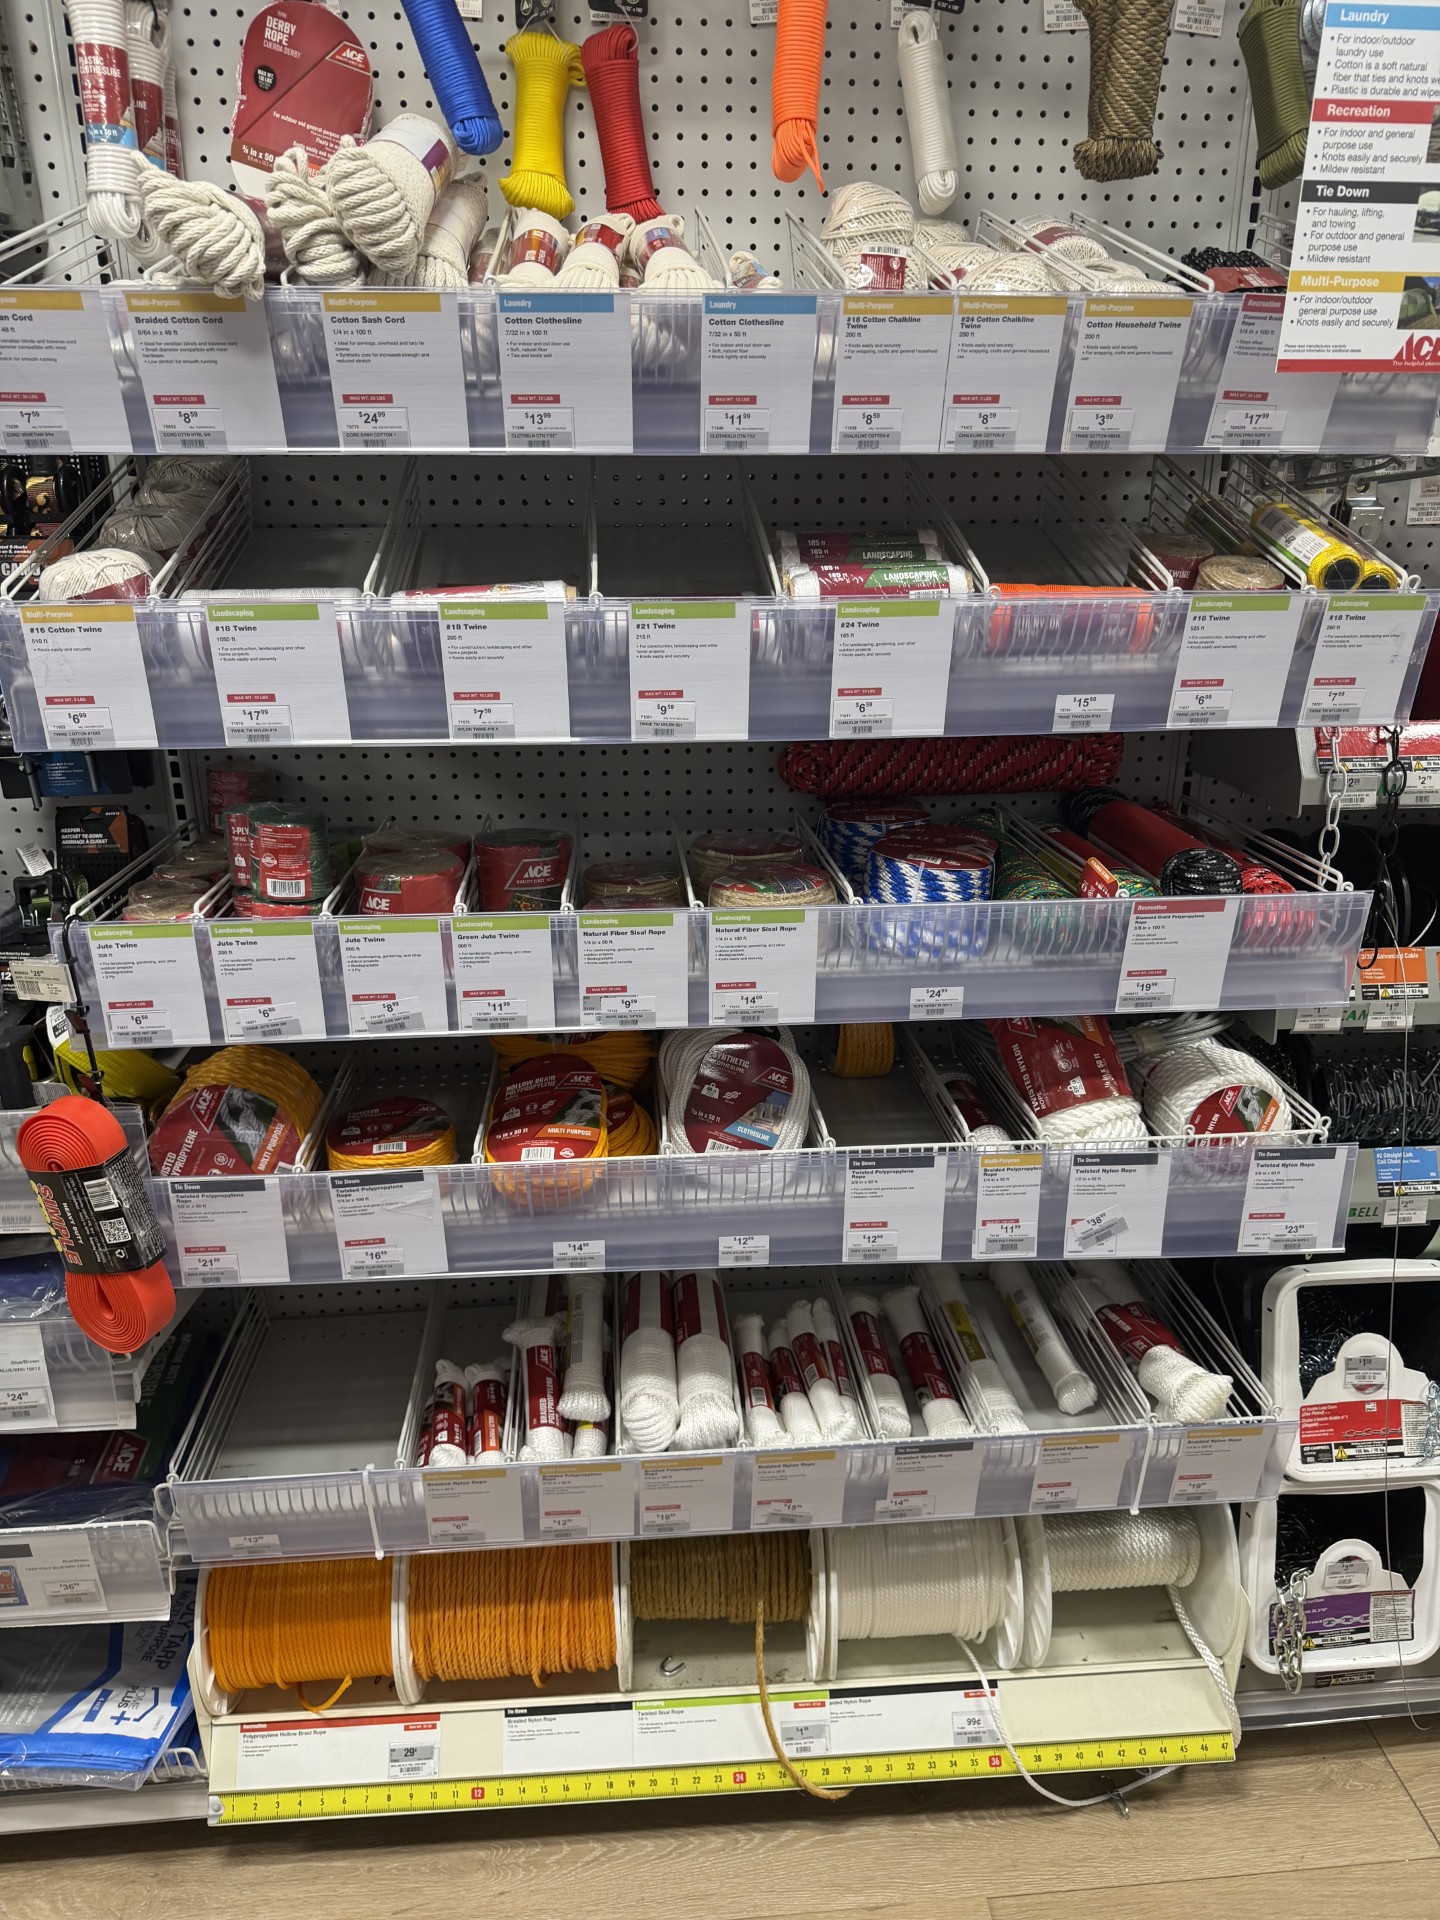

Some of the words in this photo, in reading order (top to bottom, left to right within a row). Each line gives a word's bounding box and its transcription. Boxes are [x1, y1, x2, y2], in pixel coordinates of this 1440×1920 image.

[1340, 9, 1390, 24] Laundry
[267, 15, 297, 36] DERBY
[264, 28, 288, 46] ROPE
[1336, 34, 1351, 44] For
[1353, 34, 1416, 46] indoor/outdoor
[263, 40, 284, 54] CUERDA
[284, 47, 302, 59] DERBY
[342, 48, 364, 63] ACE
[1335, 46, 1366, 58] laundry
[1368, 50, 1384, 58] use
[78, 56, 104, 66] PLASTIC
[80, 66, 122, 78] CLOTHESLINE
[1327, 104, 1391, 117] Recreation
[280, 113, 297, 125] outdoor
[298, 119, 306, 127] and
[306, 122, 322, 133] general
[322, 128, 340, 140] purpose
[1324, 128, 1338, 137] For
[1340, 128, 1366, 138] indoor
[1368, 130, 1384, 138] and
[1385, 130, 1416, 140] general
[1322, 142, 1356, 151] purpose
[1358, 142, 1374, 150] use
[1322, 152, 1346, 162] Knots
[1348, 152, 1371, 164] easily
[1372, 153, 1388, 162] and
[1390, 153, 1423, 165] securely
[1320, 164, 1349, 174] Mildew
[1351, 165, 1386, 174] resistant
[1316, 185, 1334, 197] Tie
[1336, 185, 1370, 198] Down
[1312, 207, 1326, 216] For
[1328, 207, 1360, 218] hauling,
[1362, 208, 1386, 218] lifting,
[1312, 220, 1327, 228] and
[1329, 220, 1356, 230] towing
[1301, 275, 1380, 288] Multi-Purpose
[130, 298, 180, 307] Multi-Purpose
[504, 299, 532, 308] Laundry
[1247, 299, 1281, 308] Recreation
[12, 313, 33, 322] Cord
[135, 316, 168, 324] Braided
[171, 316, 200, 324] Cotton
[202, 316, 224, 324] Cord
[330, 316, 359, 324] Cotton
[362, 316, 382, 324] Sash
[384, 316, 405, 324] Cord
[504, 316, 533, 324] Cotton
[535, 316, 582, 324] Clothesline
[709, 318, 736, 326] Cotton
[738, 318, 784, 326] Clothesline
[1087, 321, 1113, 329] Cotton
[1115, 321, 1156, 329] Household
[1158, 321, 1182, 329] Twine
[862, 549, 913, 560] LANDSCAPING
[883, 570, 938, 582] LANDSCAPING
[212, 608, 255, 619] Landscaping
[30, 626, 46, 634] #16
[47, 626, 76, 634] Cotton
[77, 625, 102, 634] Twine
[215, 625, 230, 633] #18
[233, 624, 257, 633] Twine
[636, 622, 651, 630] #21
[653, 622, 676, 630] Twine
[840, 621, 855, 629] #24
[524, 865, 552, 878] ACE
[366, 898, 390, 910] ACE
[649, 929, 666, 937] Rope
[96, 942, 112, 950] Jute
[712, 1050, 750, 1068] SYNTHETIC
[1012, 1044, 1026, 1072] NYLON
[506, 1079, 534, 1092] HOLLOW
[534, 1075, 556, 1084] BRAID
[768, 1072, 788, 1084] ACE
[506, 1080, 556, 1097] POLYPROPYLENE
[1022, 1074, 1040, 1114] TWISTED
[194, 1088, 212, 1116] ACE
[566, 1128, 592, 1136] PURPOSE
[737, 1126, 770, 1142] CLOTHESLINE
[258, 1146, 273, 1172] MULTI
[267, 1122, 285, 1150] PURPOSE
[37, 1182, 83, 1266] SIMPLE
[62, 1202, 76, 1225] HEAVY
[72, 1226, 84, 1244] DUTY
[540, 1348, 549, 1364] ACE
[546, 1376, 555, 1424] POLYPROPYLENE
[118, 1685, 140, 1708] PLUS
[243, 1732, 279, 1740] Polypropylene
[430, 1792, 438, 1800] 10
[474, 1789, 482, 1797] 12
[540, 1785, 548, 1794] 15
[649, 1778, 657, 1787] 20
[736, 1774, 744, 1782] 24
[864, 1765, 873, 1773] 30
[991, 1757, 1000, 1766] 36
[1075, 1751, 1084, 1760] 40
